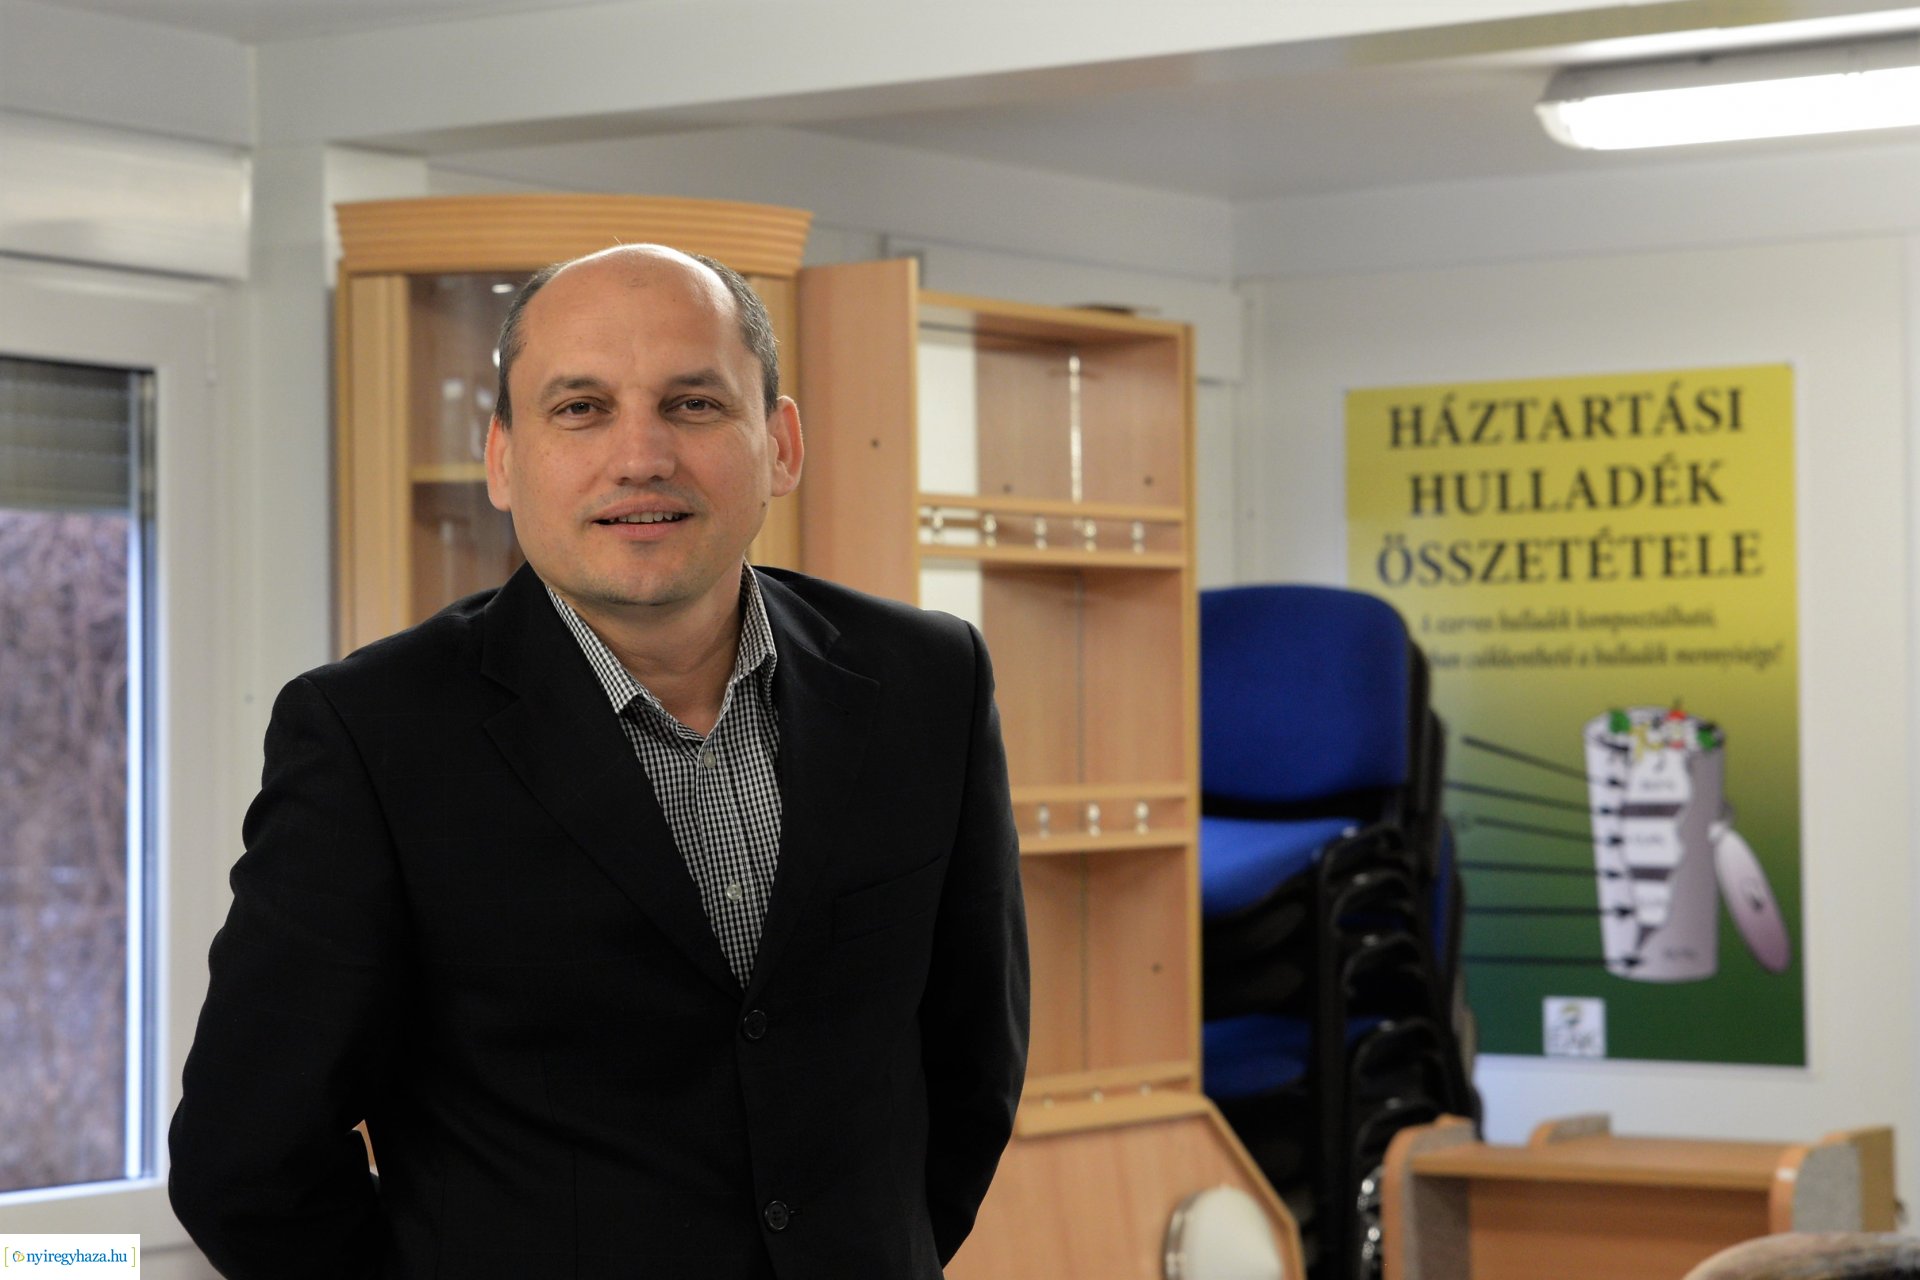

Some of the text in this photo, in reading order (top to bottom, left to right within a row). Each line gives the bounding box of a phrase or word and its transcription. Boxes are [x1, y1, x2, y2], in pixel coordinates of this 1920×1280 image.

[1388, 381, 1744, 449] HÁZTARTÁSI
[1406, 453, 1725, 517] HULLADÉK
[1376, 527, 1765, 588] ÖSSZETÉTELE
